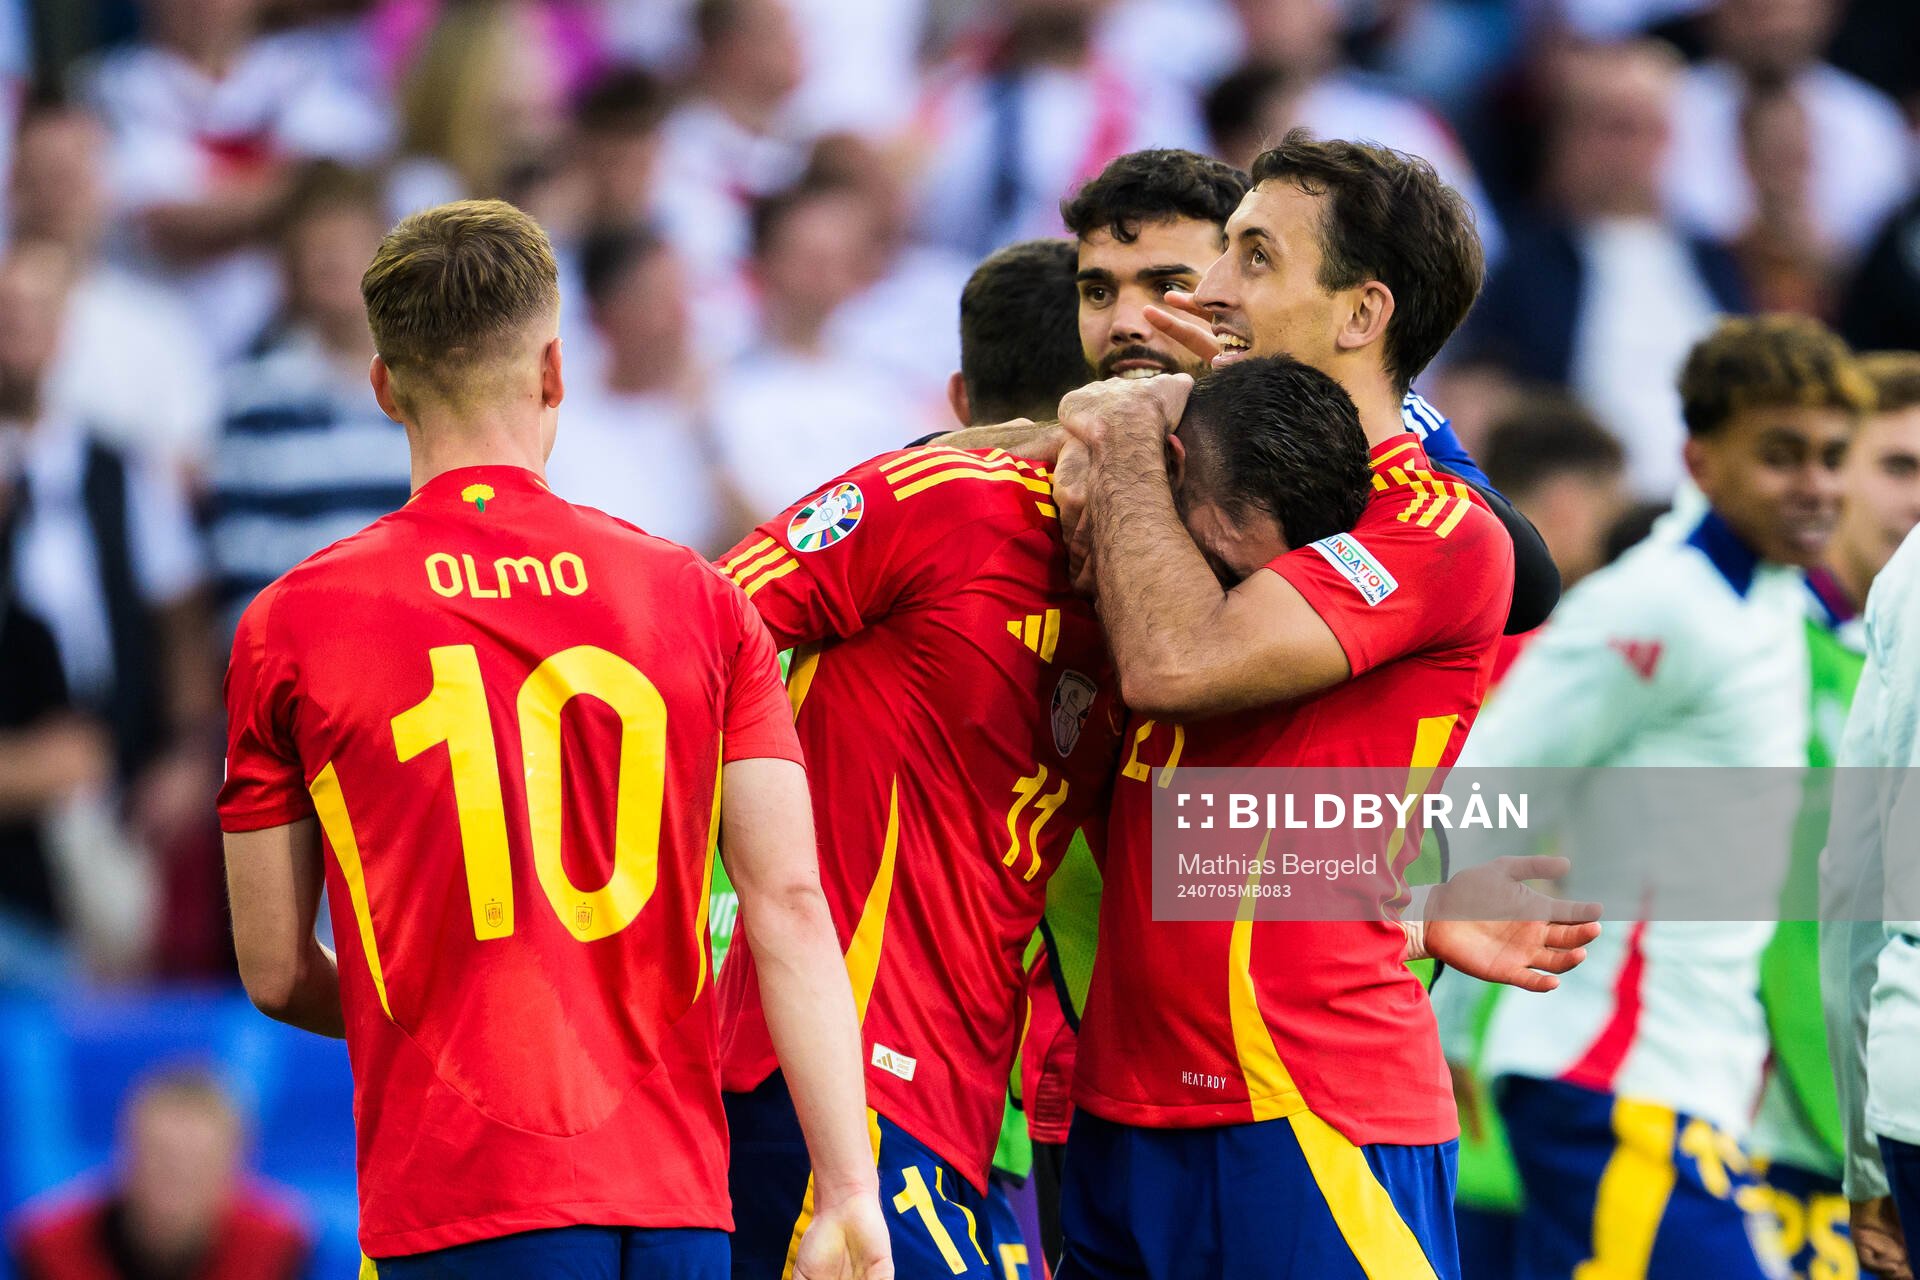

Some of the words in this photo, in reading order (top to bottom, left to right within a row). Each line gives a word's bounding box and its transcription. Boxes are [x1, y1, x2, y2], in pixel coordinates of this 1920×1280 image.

[425, 551, 589, 600] OLMO
[390, 643, 668, 943] 10
[1002, 762, 1070, 883] 11
[1182, 1070, 1227, 1090] HEAT.RDY
